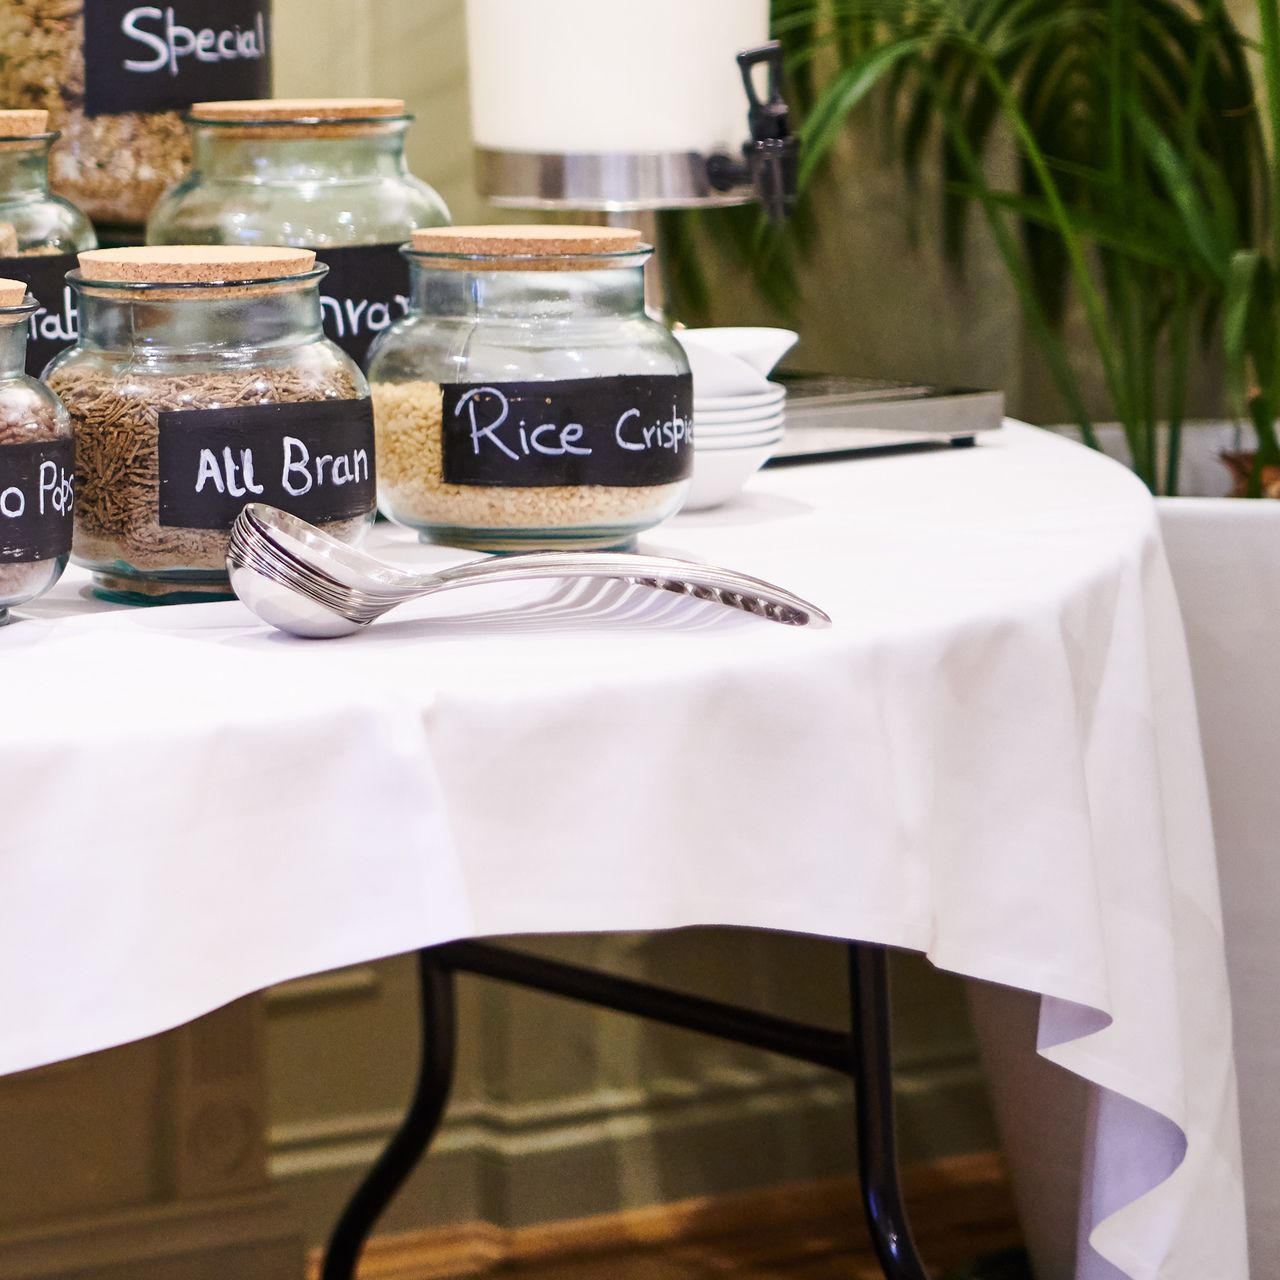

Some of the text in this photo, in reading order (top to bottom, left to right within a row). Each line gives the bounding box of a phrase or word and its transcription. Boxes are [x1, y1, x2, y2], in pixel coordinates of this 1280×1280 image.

[121, 6, 265, 77] Special
[454, 387, 593, 461] Rice
[39, 460, 75, 517] Pops
[195, 435, 369, 498] All Bran
